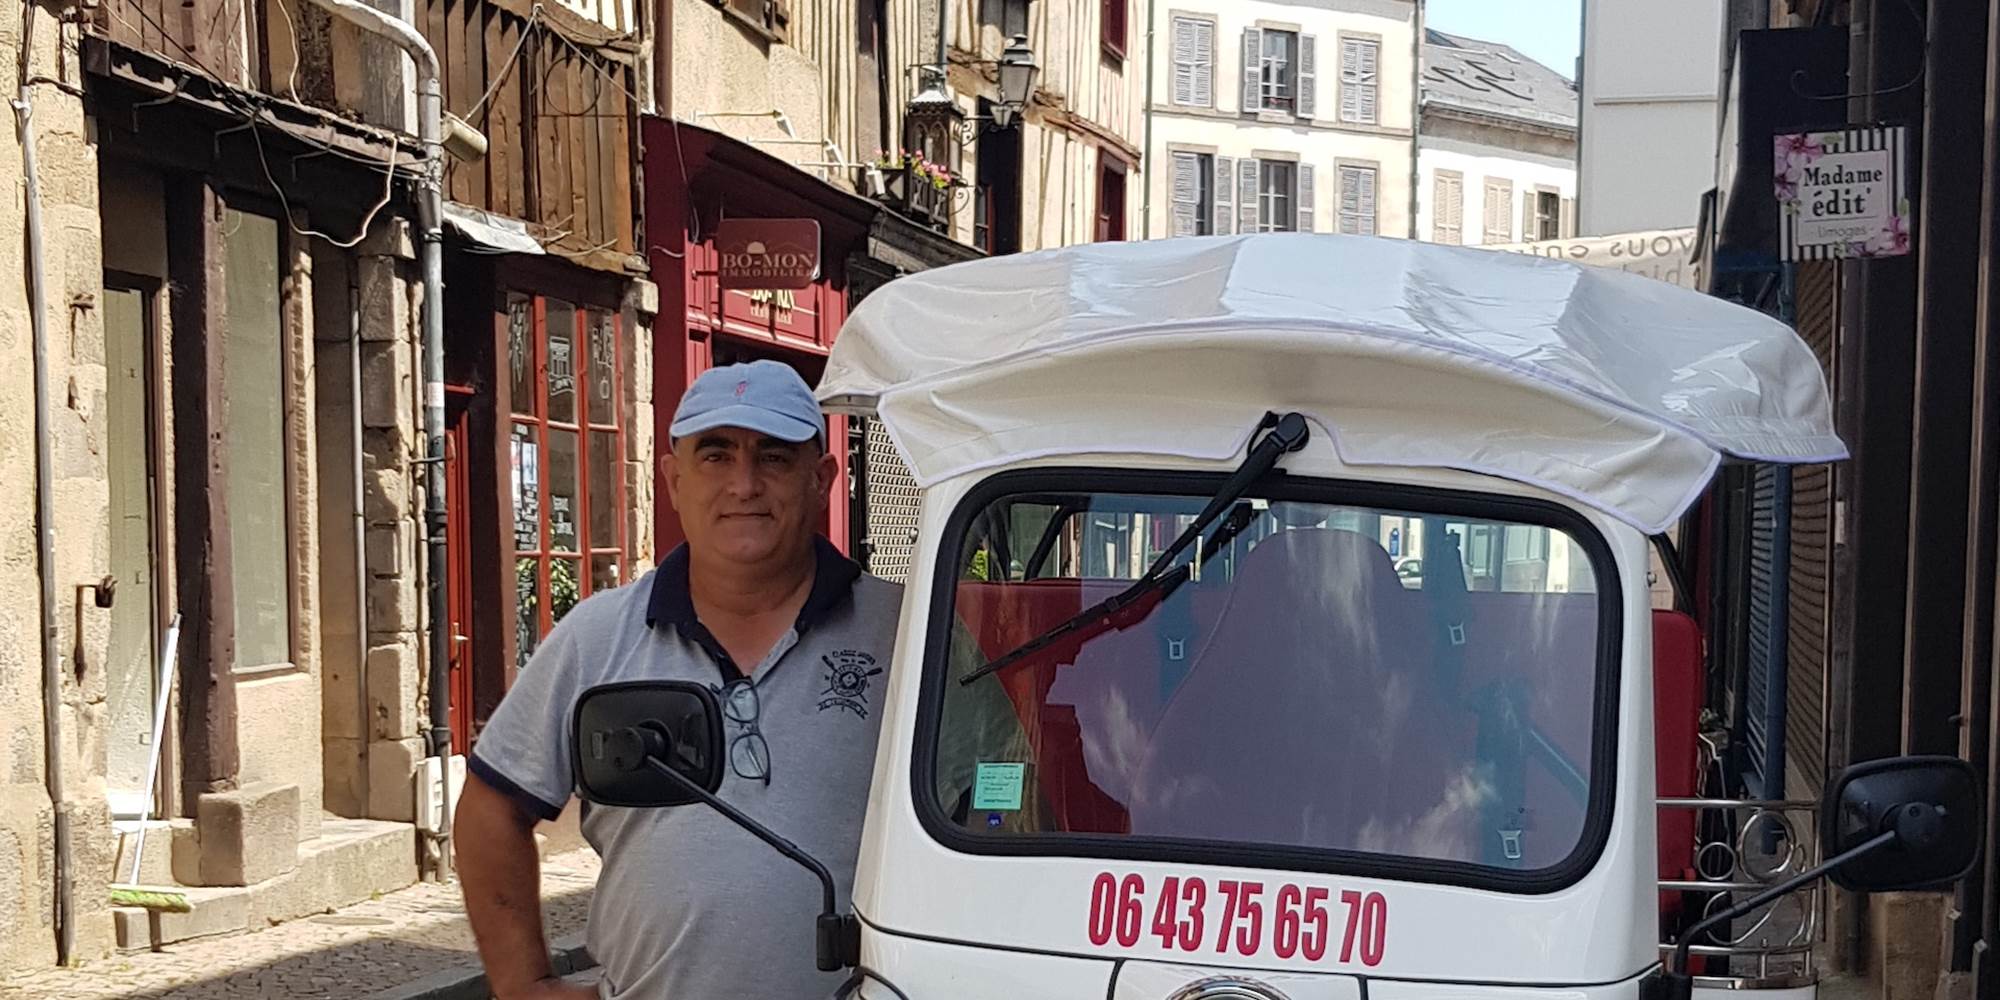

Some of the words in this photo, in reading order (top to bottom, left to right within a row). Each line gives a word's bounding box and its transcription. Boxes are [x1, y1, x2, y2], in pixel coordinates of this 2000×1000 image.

[1803, 165, 1883, 187] Madame
[1812, 187, 1871, 217] édit'
[722, 253, 815, 268] BO-MON
[1088, 871, 1145, 948] 06
[1151, 876, 1207, 952] 43
[1215, 880, 1264, 956] 75
[1273, 883, 1329, 962] 65
[1339, 889, 1388, 967] 70
